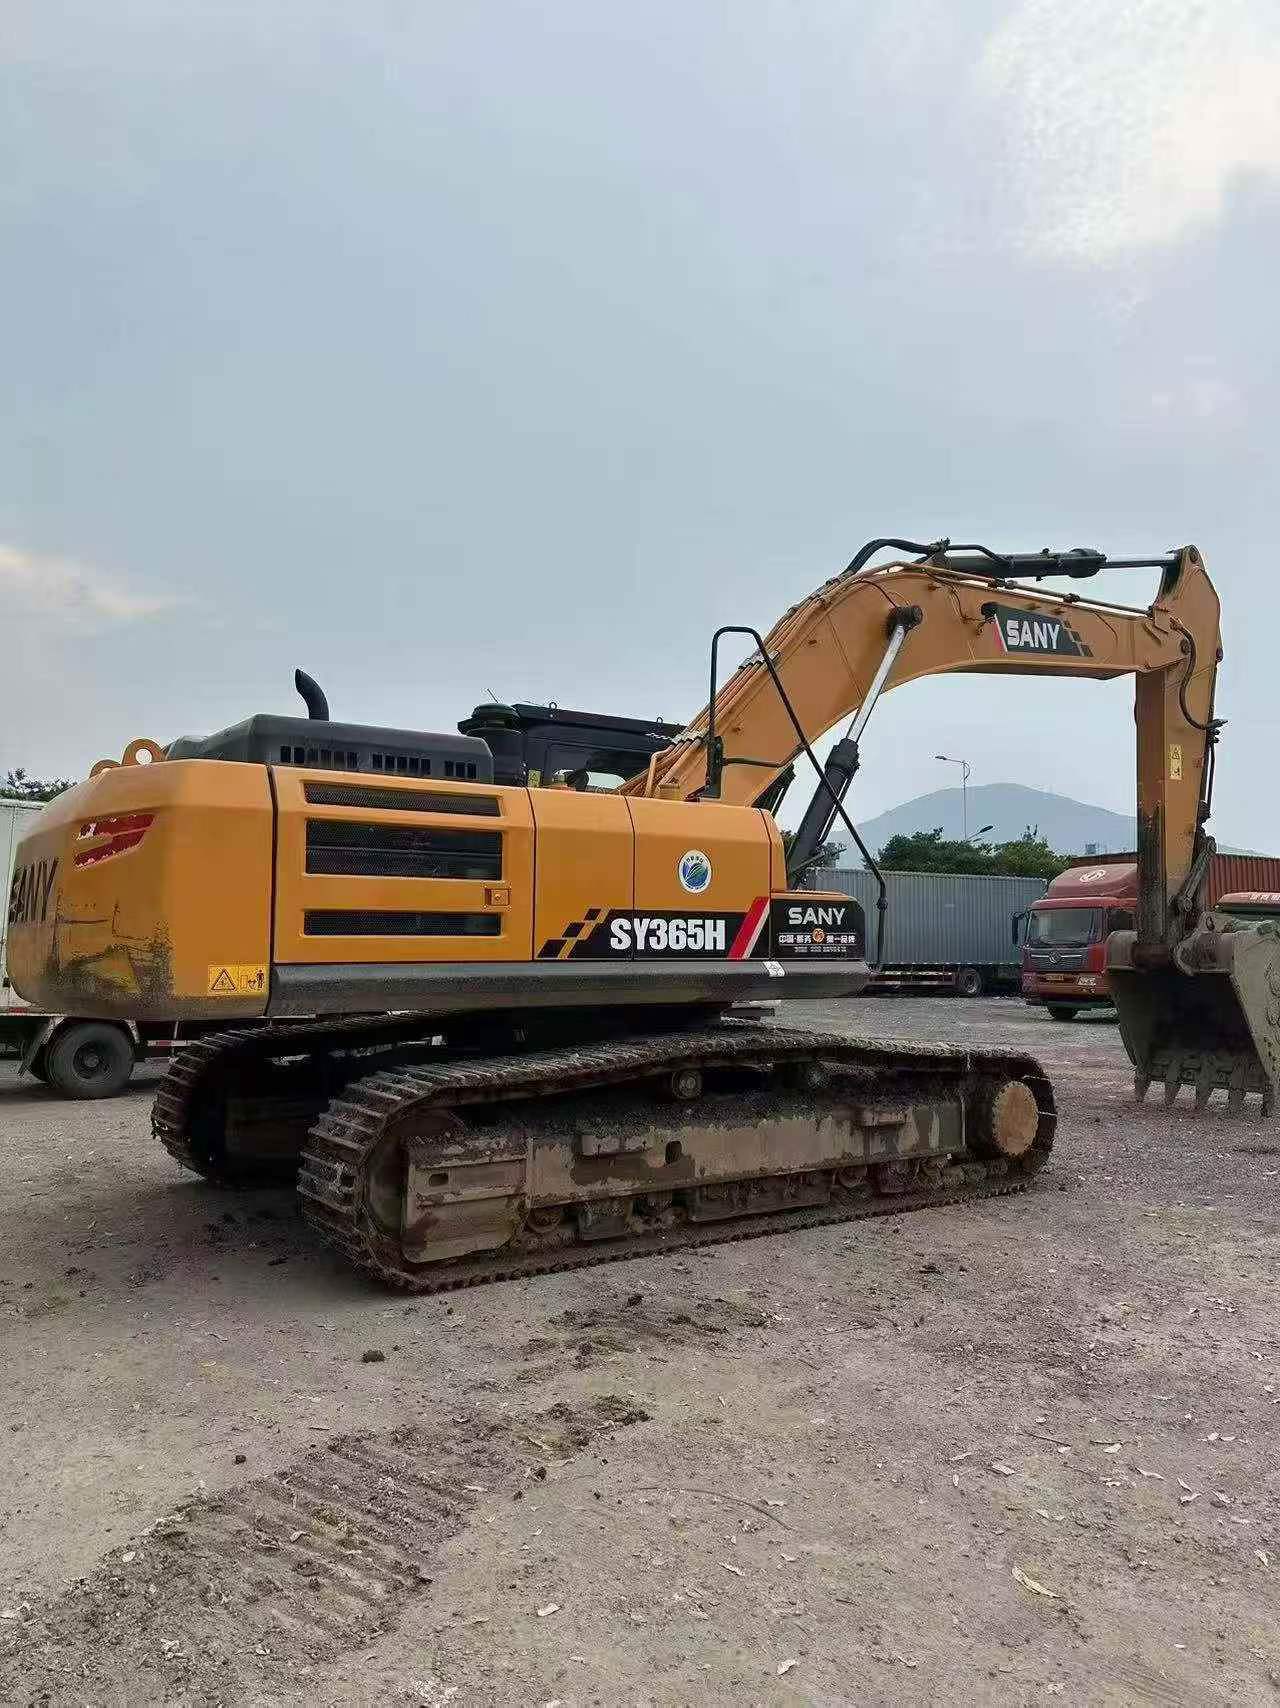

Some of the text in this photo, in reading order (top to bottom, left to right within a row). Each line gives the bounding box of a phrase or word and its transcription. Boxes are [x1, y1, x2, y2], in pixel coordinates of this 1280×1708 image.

[1006, 619, 1061, 650] SANY
[788, 907, 846, 925] SANY
[610, 918, 726, 951] SY365H
